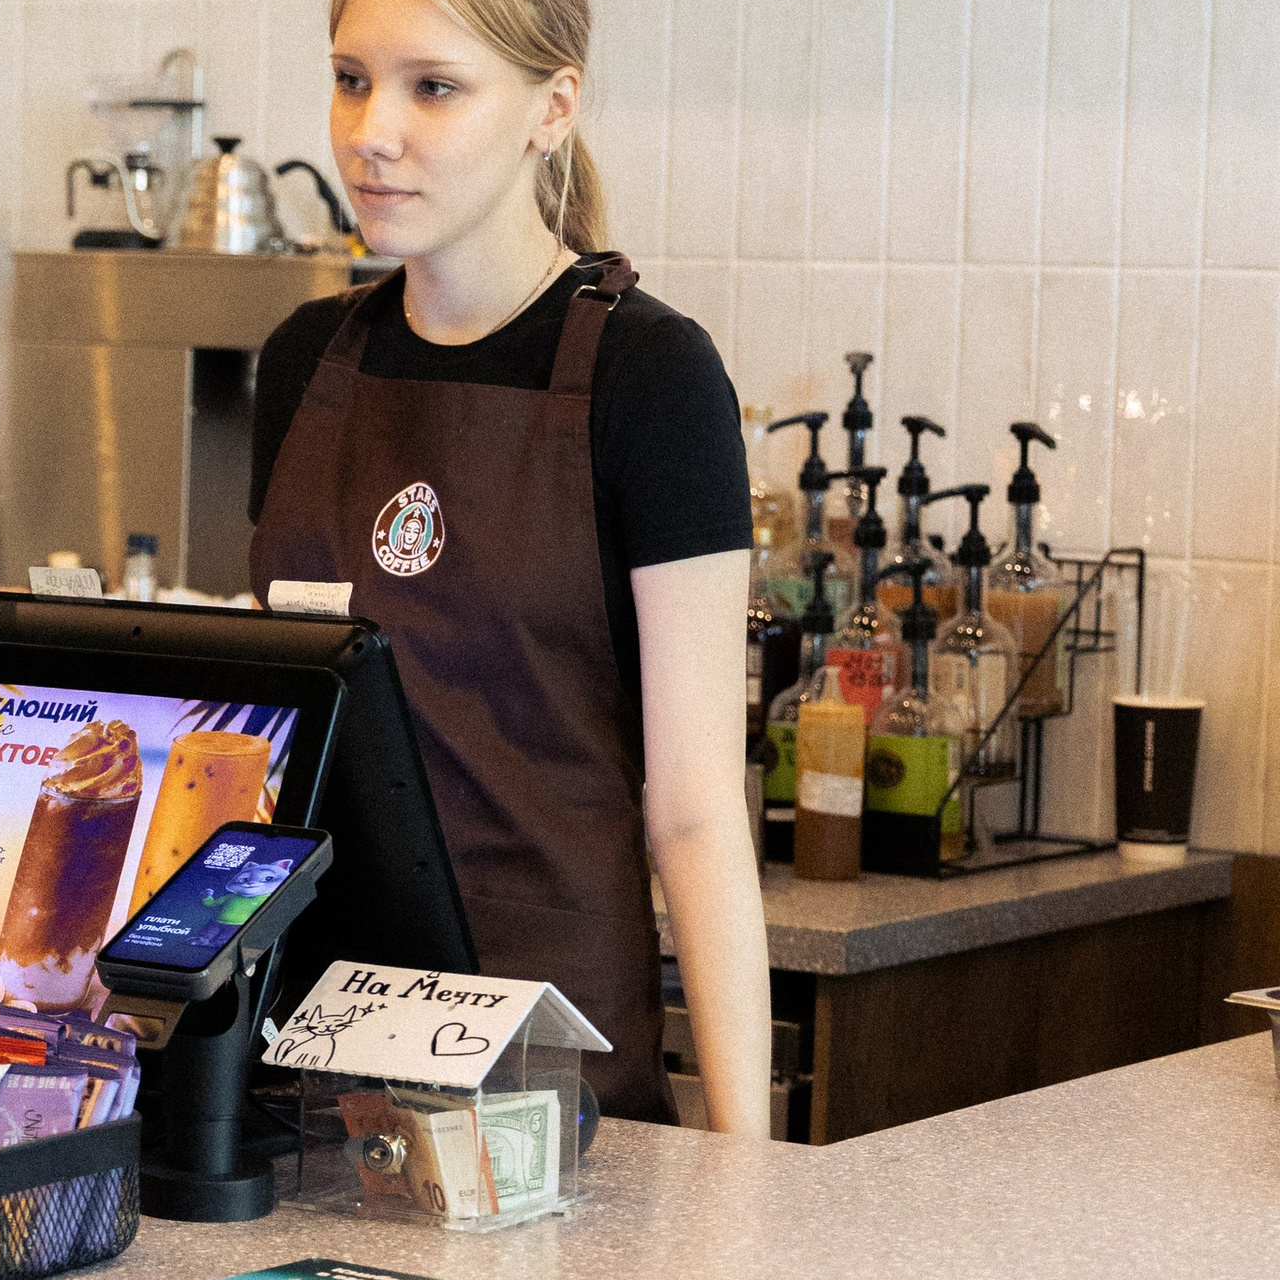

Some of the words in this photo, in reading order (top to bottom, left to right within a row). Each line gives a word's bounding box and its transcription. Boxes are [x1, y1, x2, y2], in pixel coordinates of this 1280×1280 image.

[398, 487, 437, 513] STARS
[378, 545, 430, 573] COFFEE
[135, 923, 192, 935] улыбкой
[144, 915, 181, 925] плати
[338, 970, 391, 996] На
[397, 977, 508, 1008] Мечту
